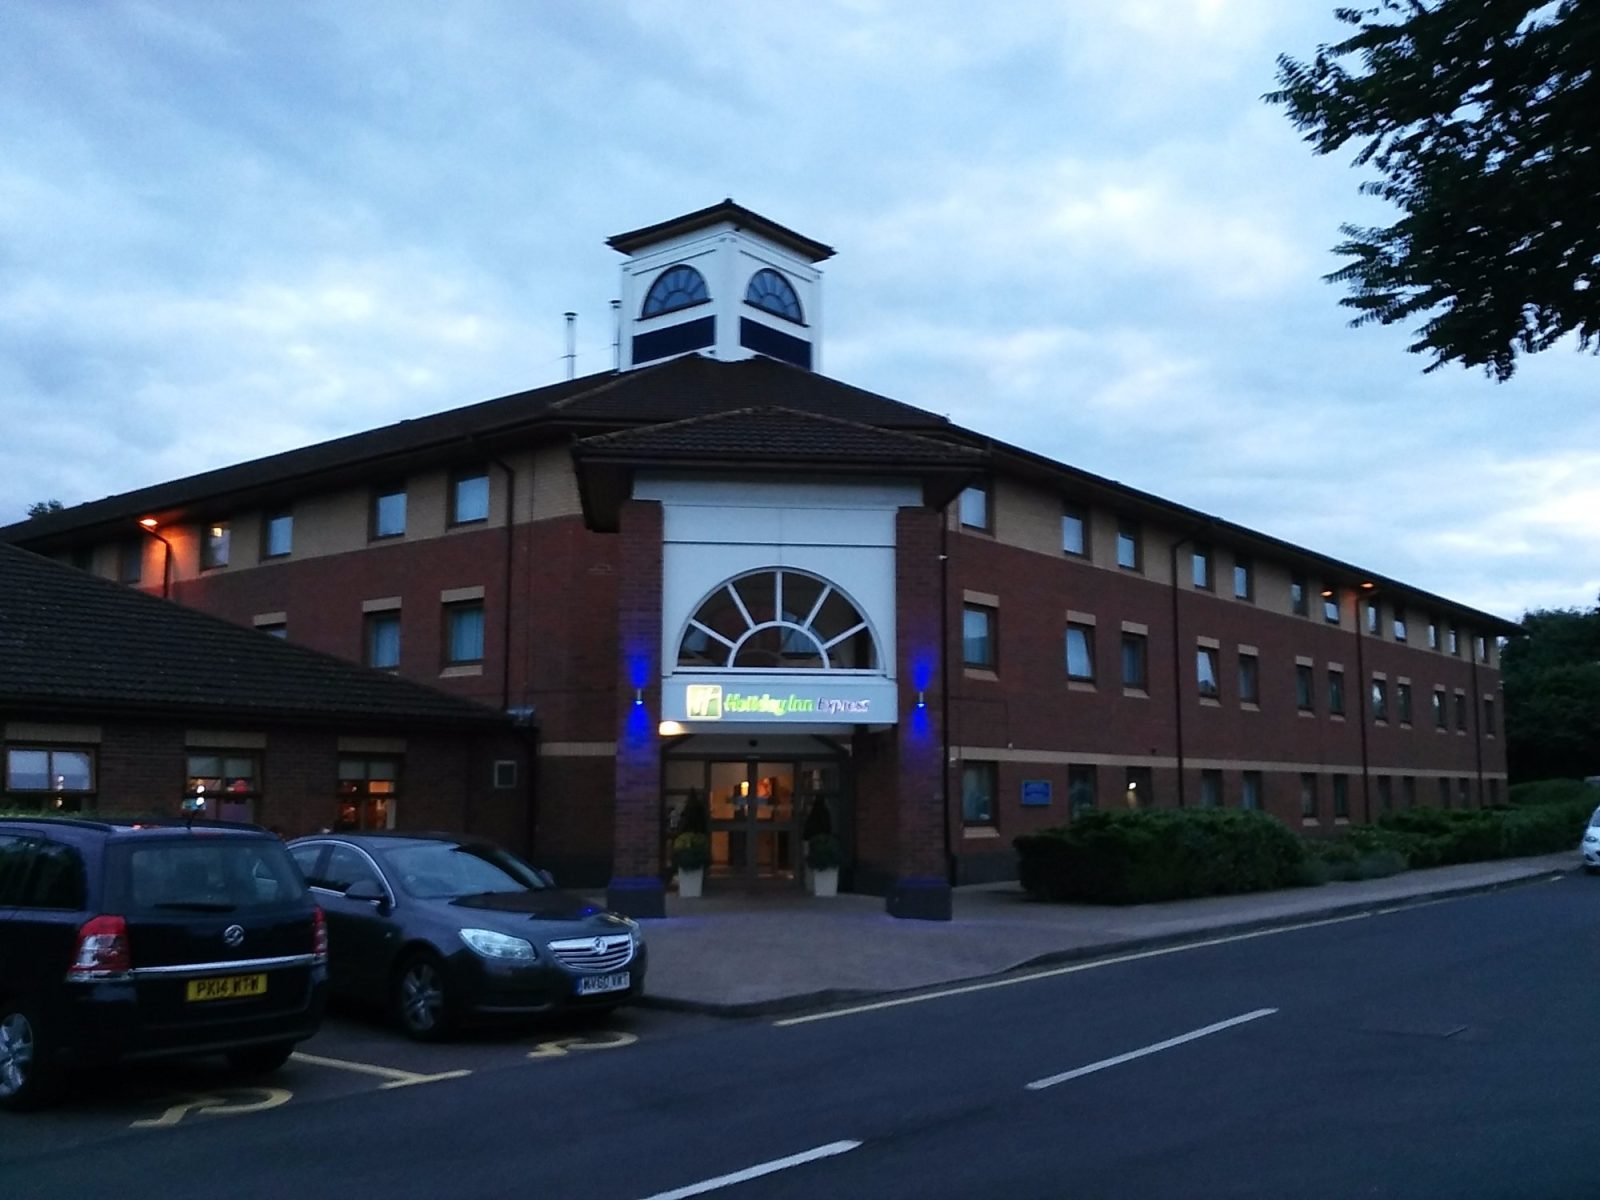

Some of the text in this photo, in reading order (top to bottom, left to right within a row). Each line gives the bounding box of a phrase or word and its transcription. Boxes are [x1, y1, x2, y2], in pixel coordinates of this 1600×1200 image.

[724, 693, 871, 716] Holiday Inn Express
